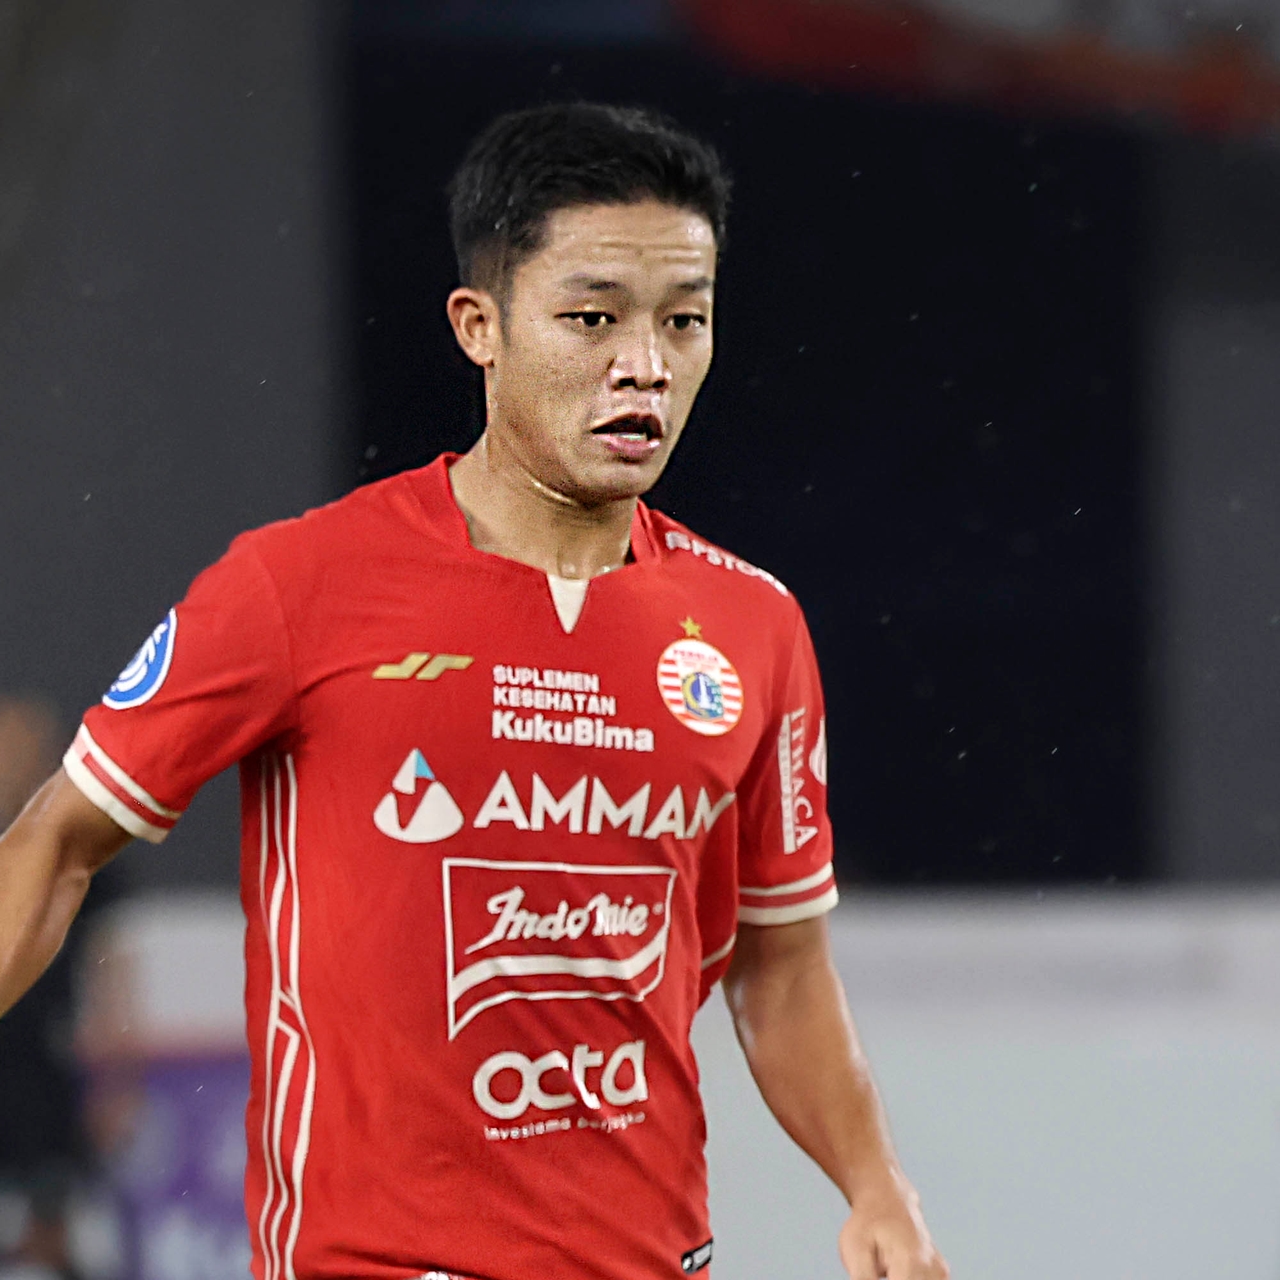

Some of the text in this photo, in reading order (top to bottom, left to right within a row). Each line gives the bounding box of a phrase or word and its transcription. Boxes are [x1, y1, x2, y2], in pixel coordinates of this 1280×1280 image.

[492, 664, 600, 694] SUPLEMEN
[492, 685, 617, 716] KESEHATAN
[491, 708, 655, 752] KukuBima
[472, 769, 737, 841] AMMAN
[472, 1040, 649, 1120] octa
